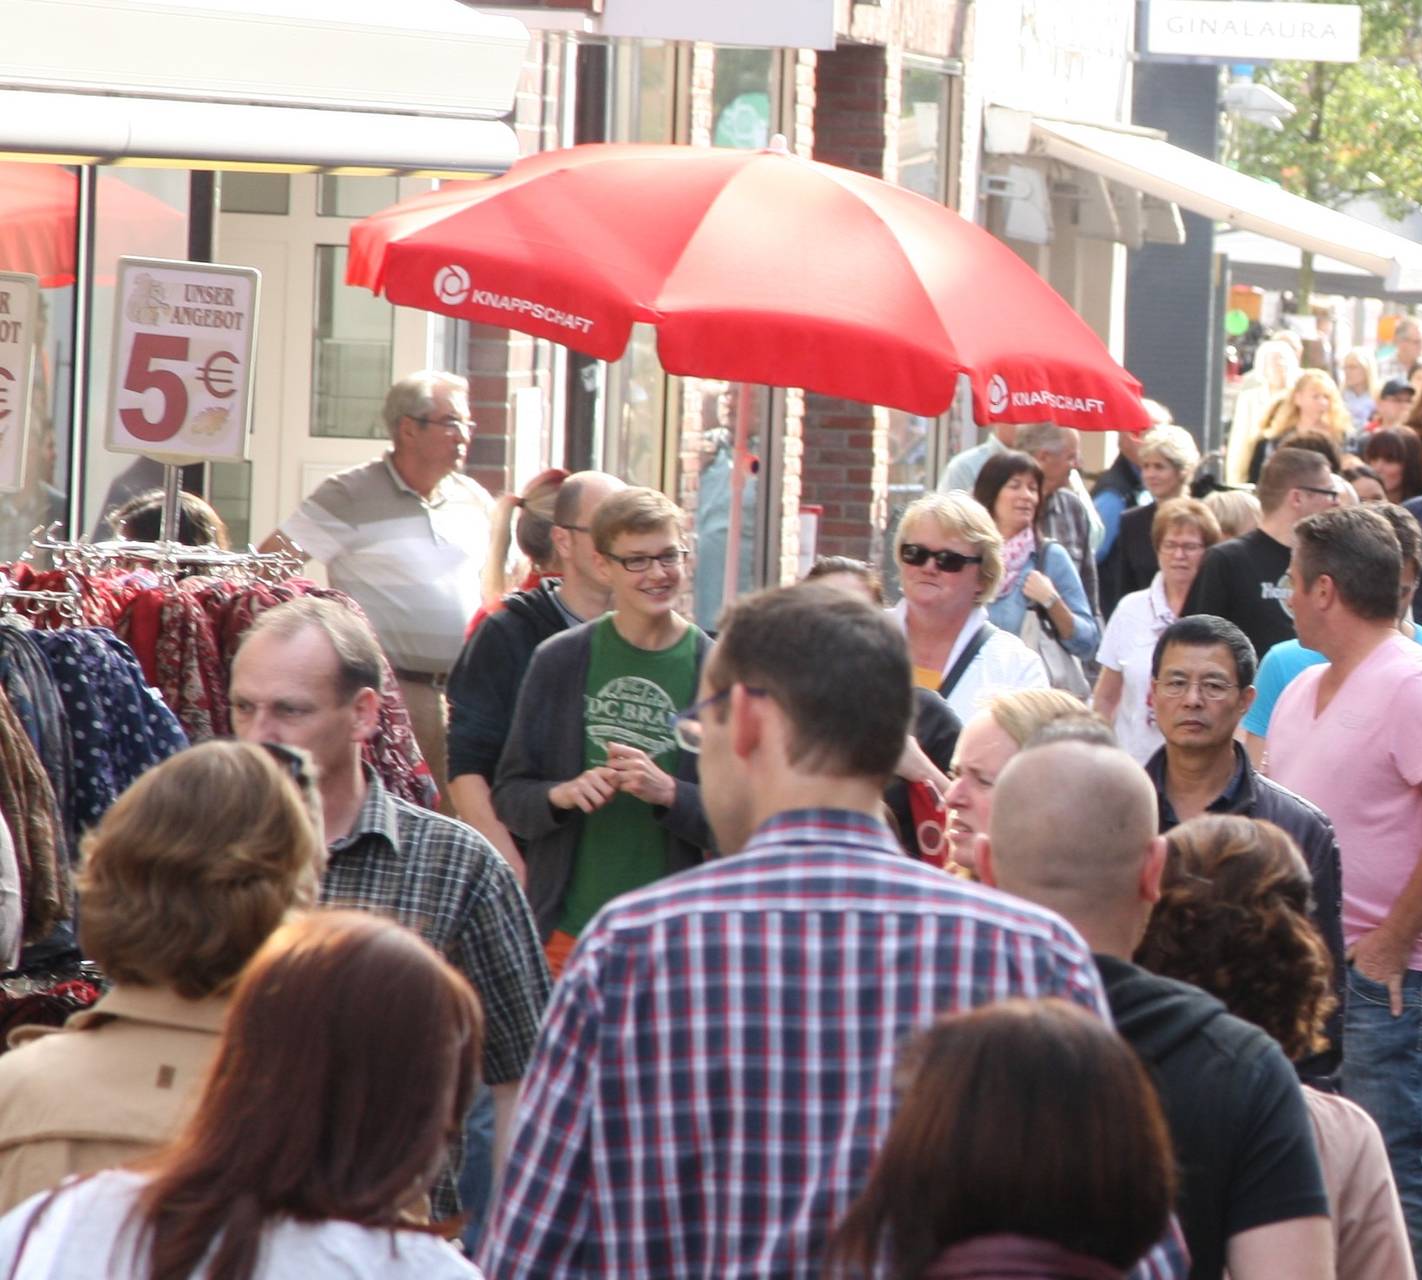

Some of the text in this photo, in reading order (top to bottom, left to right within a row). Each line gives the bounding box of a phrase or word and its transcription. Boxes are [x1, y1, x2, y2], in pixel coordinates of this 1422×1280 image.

[184, 283, 236, 307] UNSER
[170, 307, 245, 331] ANGEBOT
[472, 289, 595, 334] KNAPPSCHAFT
[622, 702, 669, 725] BRA
